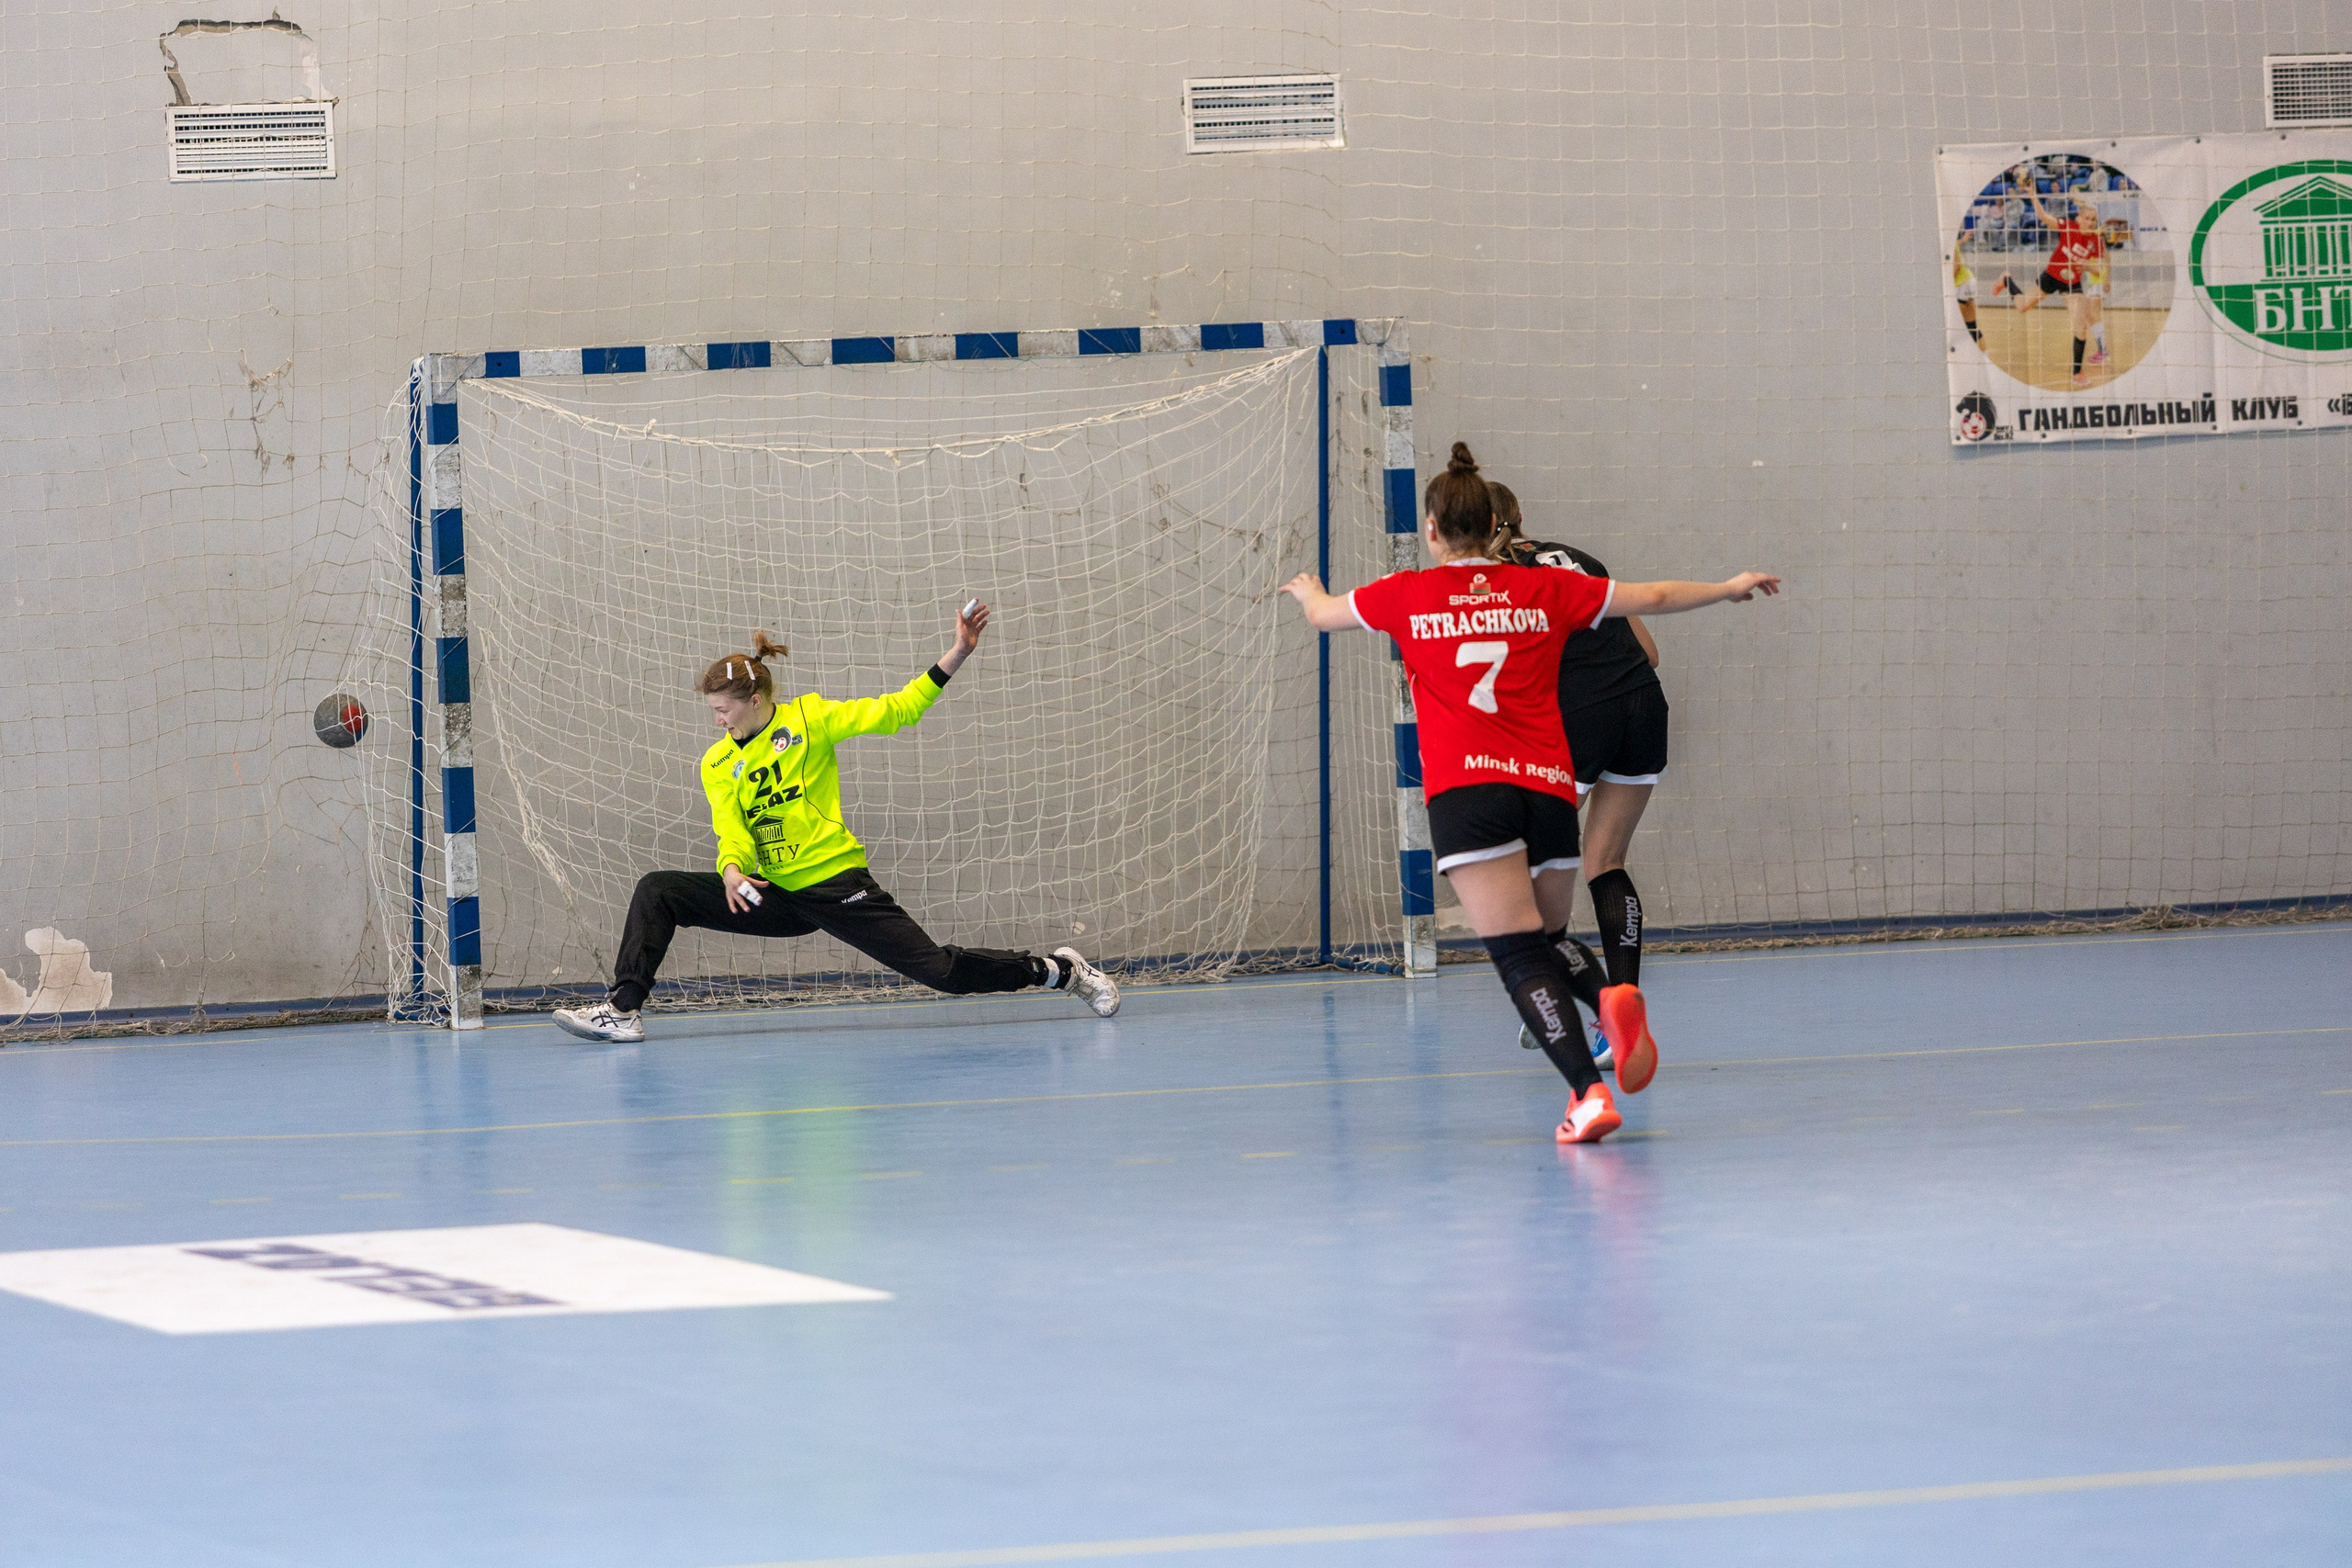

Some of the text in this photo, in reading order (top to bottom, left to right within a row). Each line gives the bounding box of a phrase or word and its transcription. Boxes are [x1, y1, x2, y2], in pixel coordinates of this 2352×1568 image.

[2018, 392, 2216, 432] ГАНДБОЛЬНЫЙ
[2232, 396, 2299, 421] КЛУБ
[1449, 590, 1512, 606] SPORTIX
[1409, 607, 1550, 640] PETRACHKOVA
[1455, 640, 1509, 715] 7
[710, 749, 734, 769] Kempa
[1464, 754, 1574, 787] Minsk Region
[748, 760, 783, 800] 21
[1620, 896, 1642, 947] Kempa
[1530, 987, 1567, 1044] Kempa
